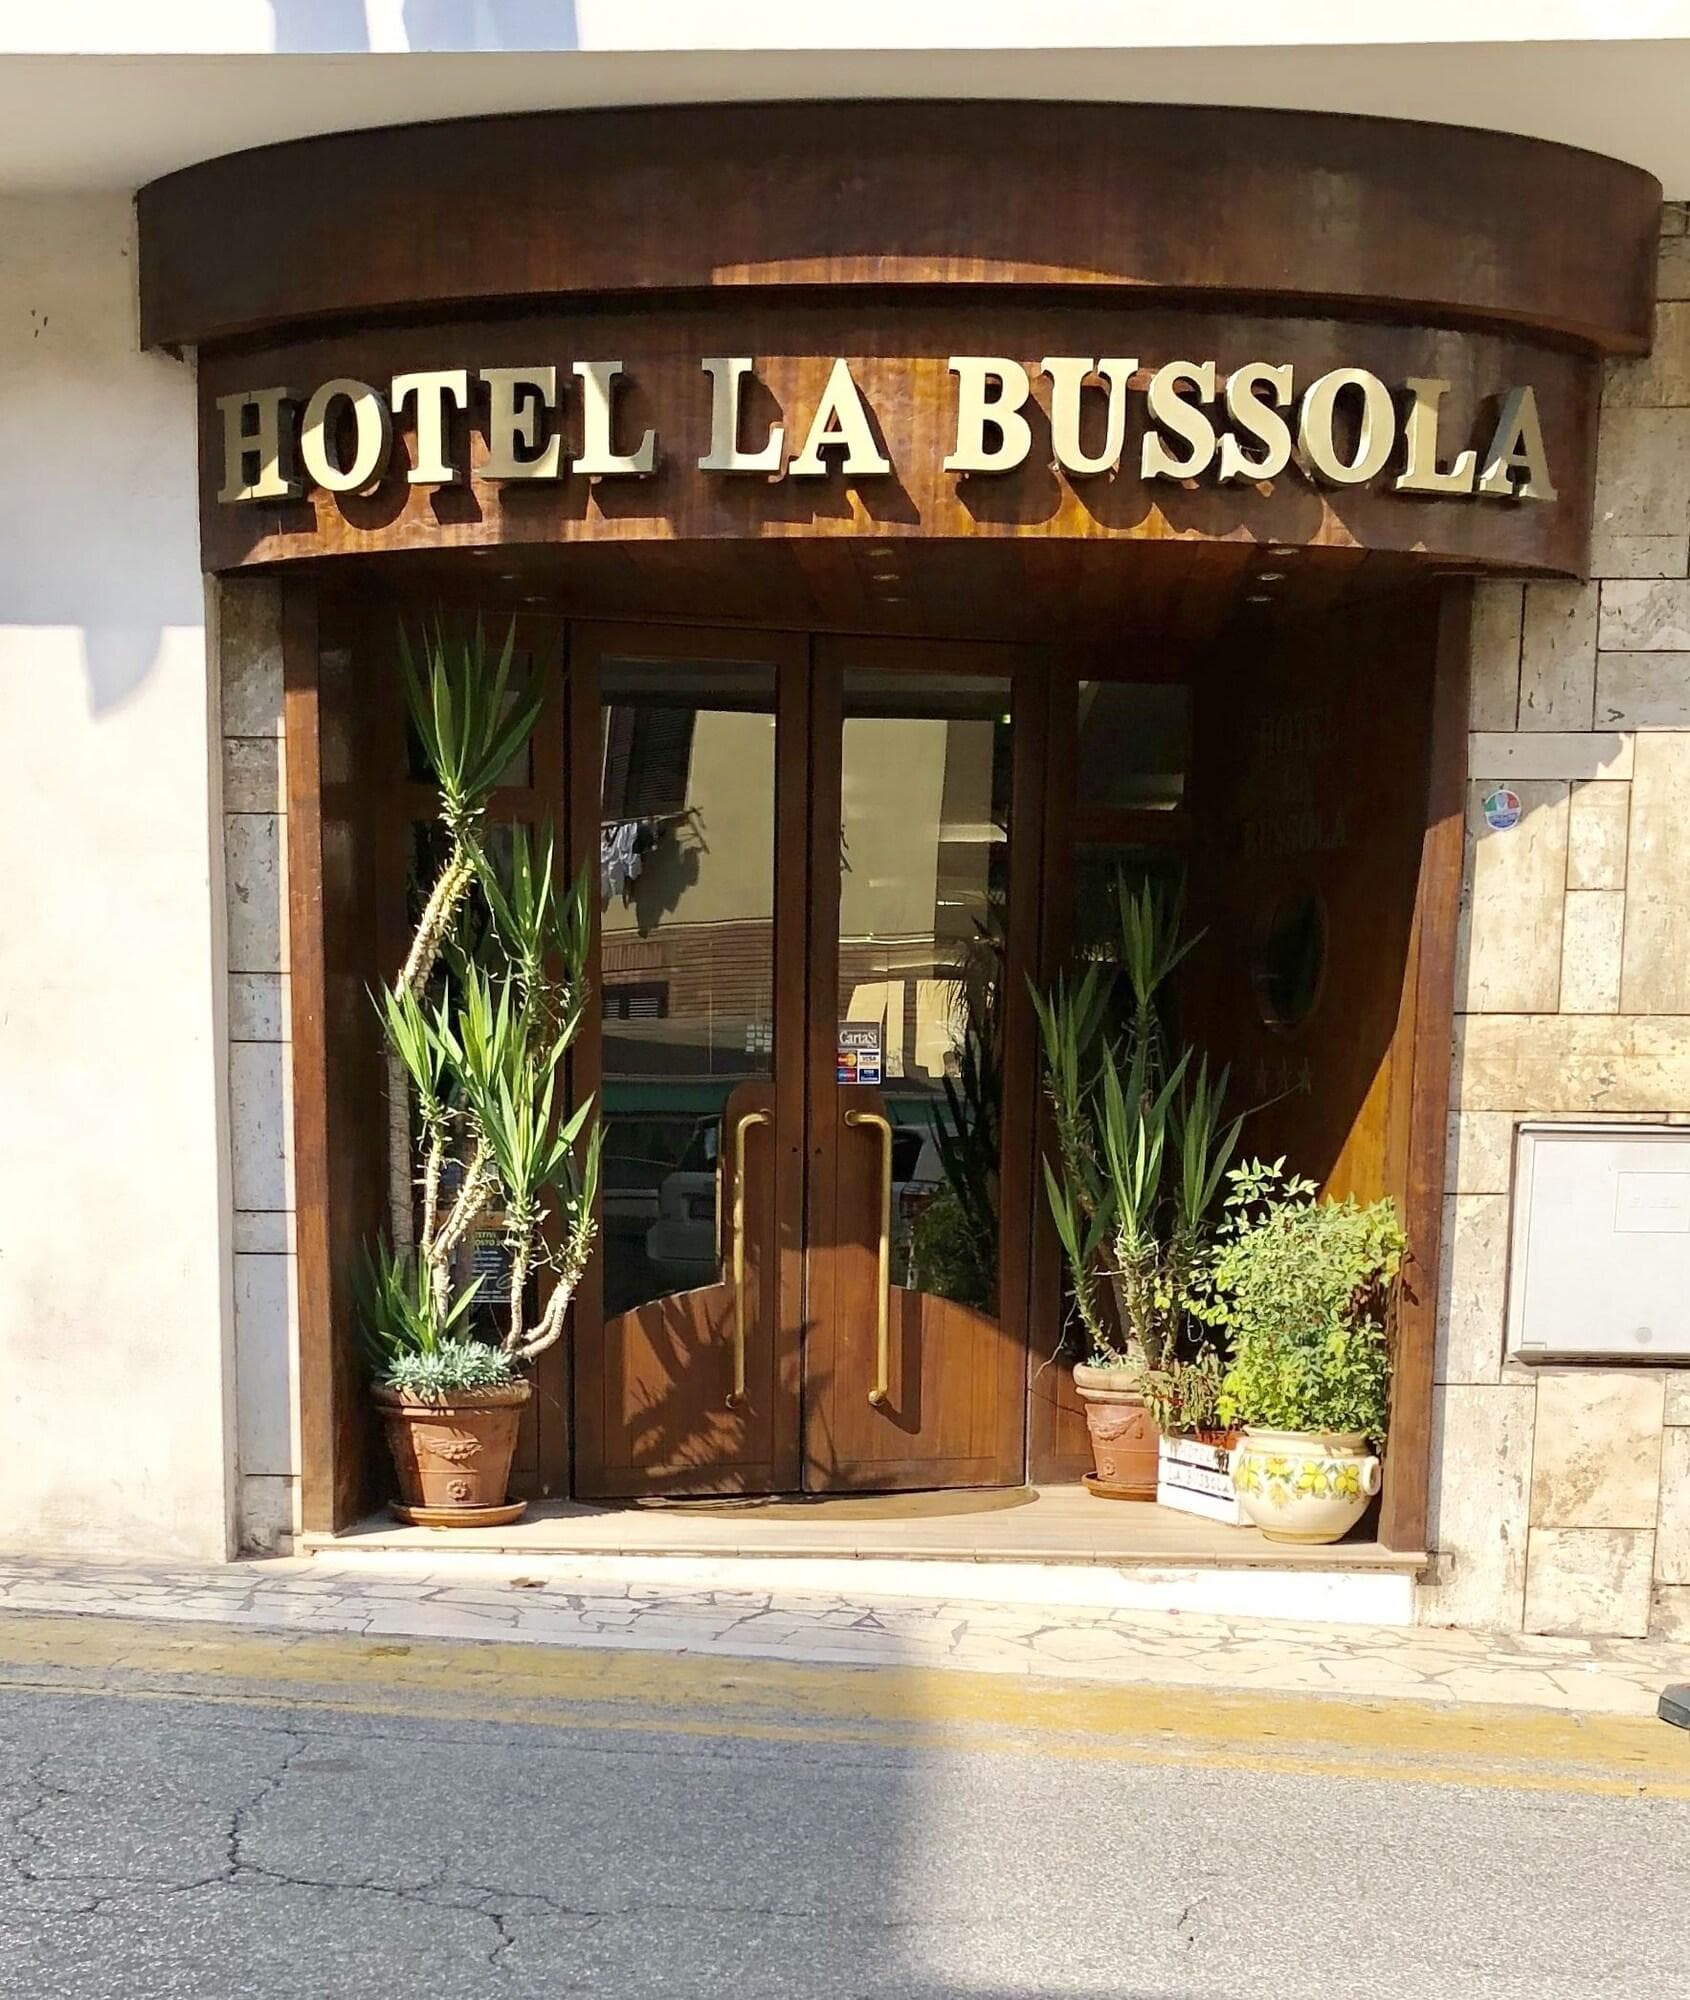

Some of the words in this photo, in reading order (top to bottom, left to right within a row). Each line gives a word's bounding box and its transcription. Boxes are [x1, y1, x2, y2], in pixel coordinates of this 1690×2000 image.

[216, 361, 657, 501] HOTEL
[698, 358, 889, 478] LA
[944, 357, 1557, 500] BUSSOLA
